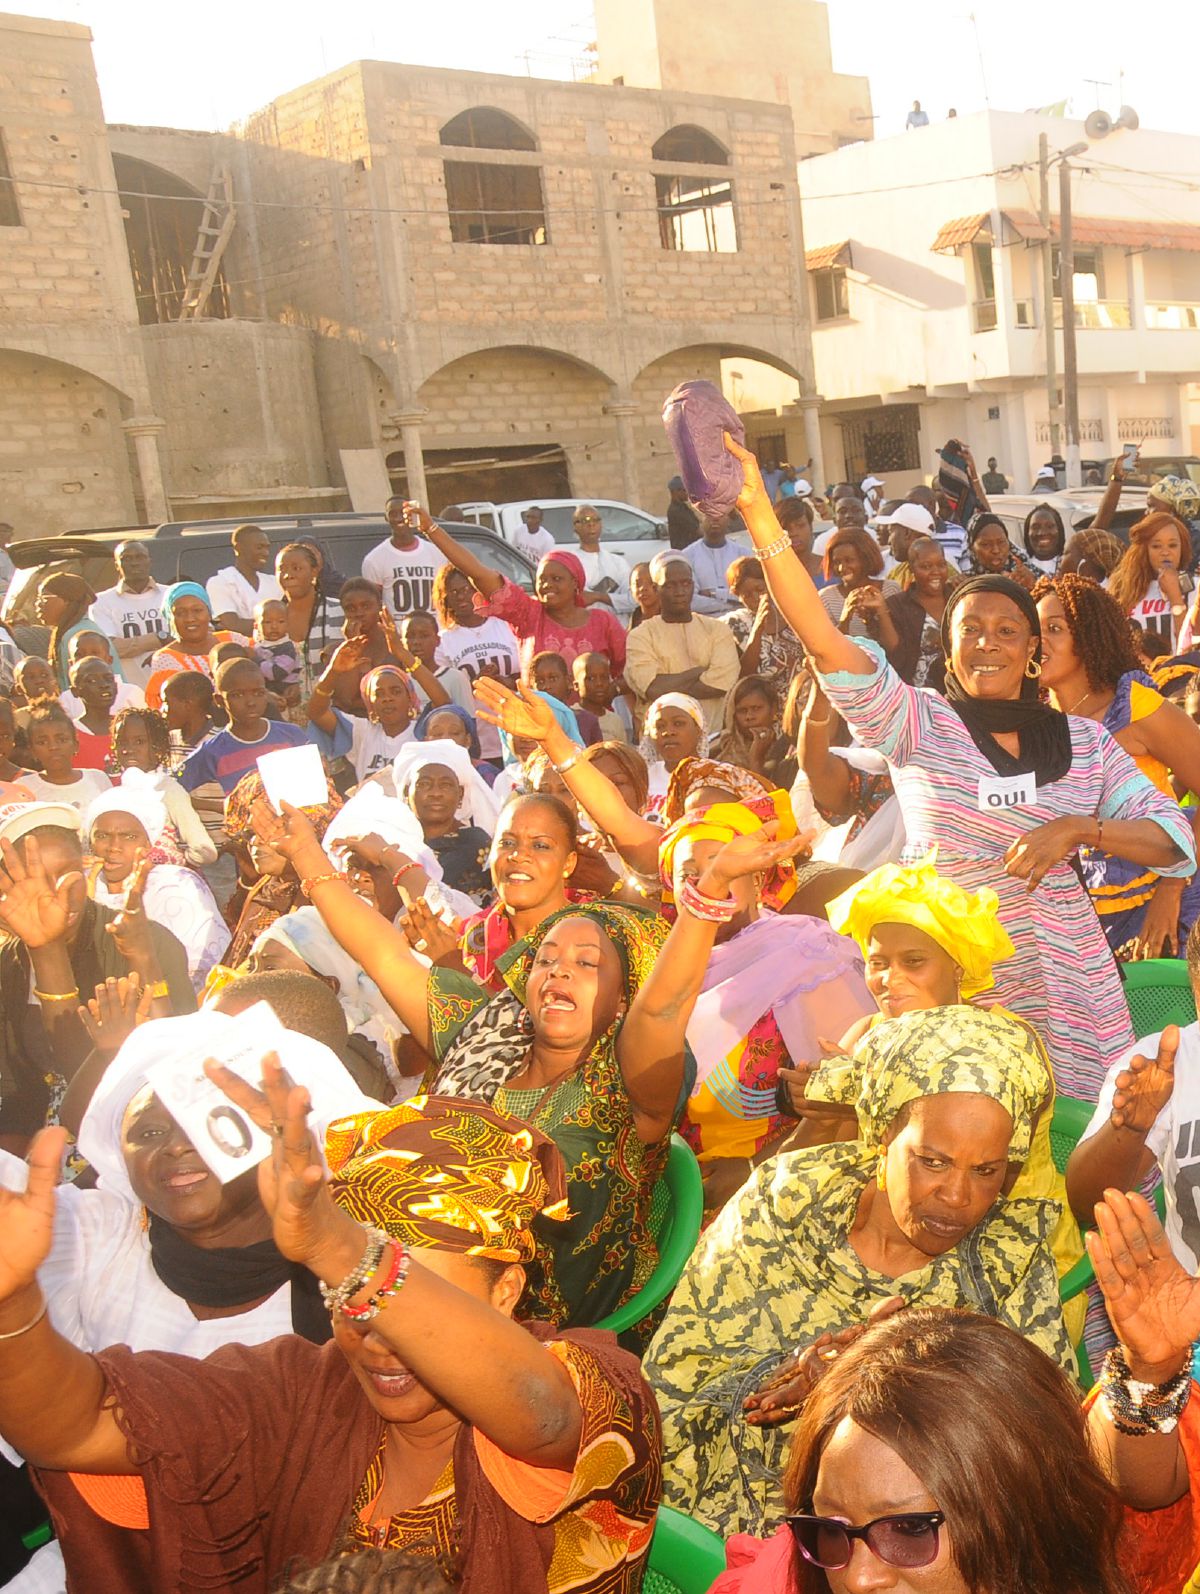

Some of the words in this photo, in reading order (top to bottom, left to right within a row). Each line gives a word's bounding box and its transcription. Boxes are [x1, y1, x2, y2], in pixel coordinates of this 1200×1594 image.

[393, 567, 404, 578] JE
[406, 566, 434, 577] VOTE
[121, 612, 135, 623] JE
[987, 791, 1026, 807] OUI
